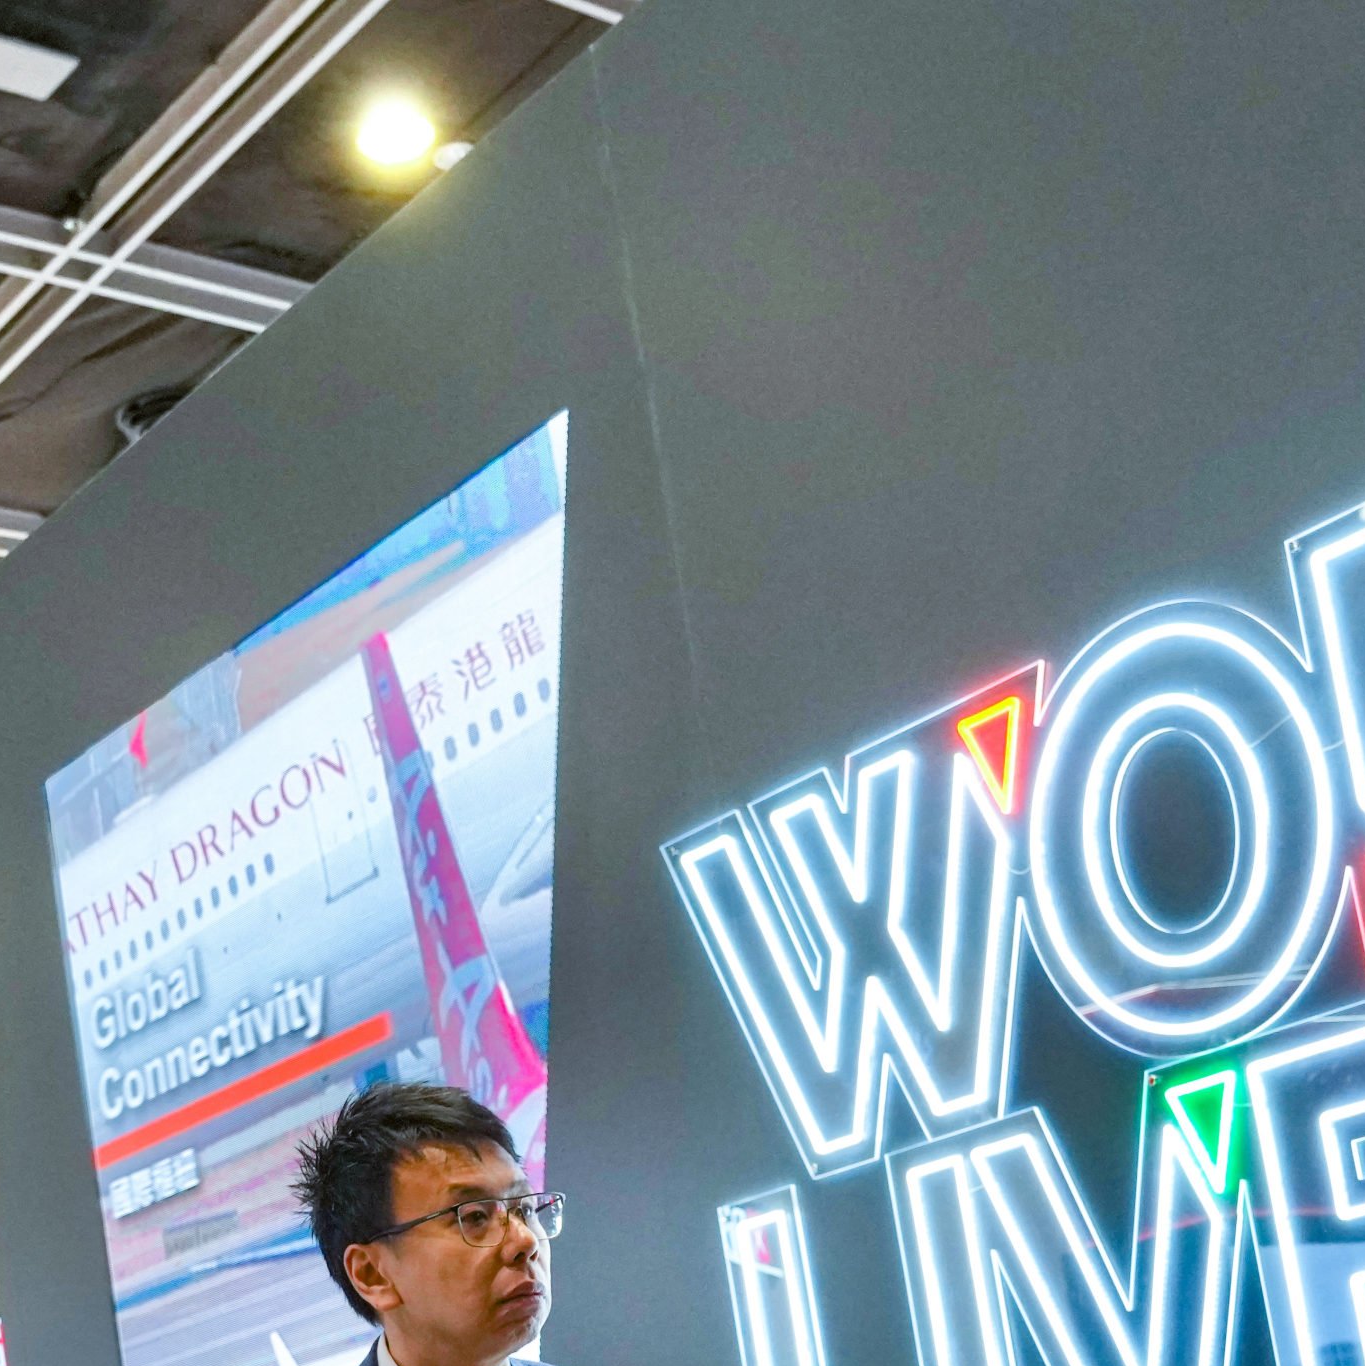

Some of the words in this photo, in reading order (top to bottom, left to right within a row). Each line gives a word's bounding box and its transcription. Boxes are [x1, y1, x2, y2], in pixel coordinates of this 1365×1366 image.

[363, 609, 546, 757] 泰港龍
[63, 859, 158, 954] THAY
[170, 738, 346, 884] DRAGON
[93, 947, 202, 1049] Global
[98, 974, 325, 1119] Connectivity
